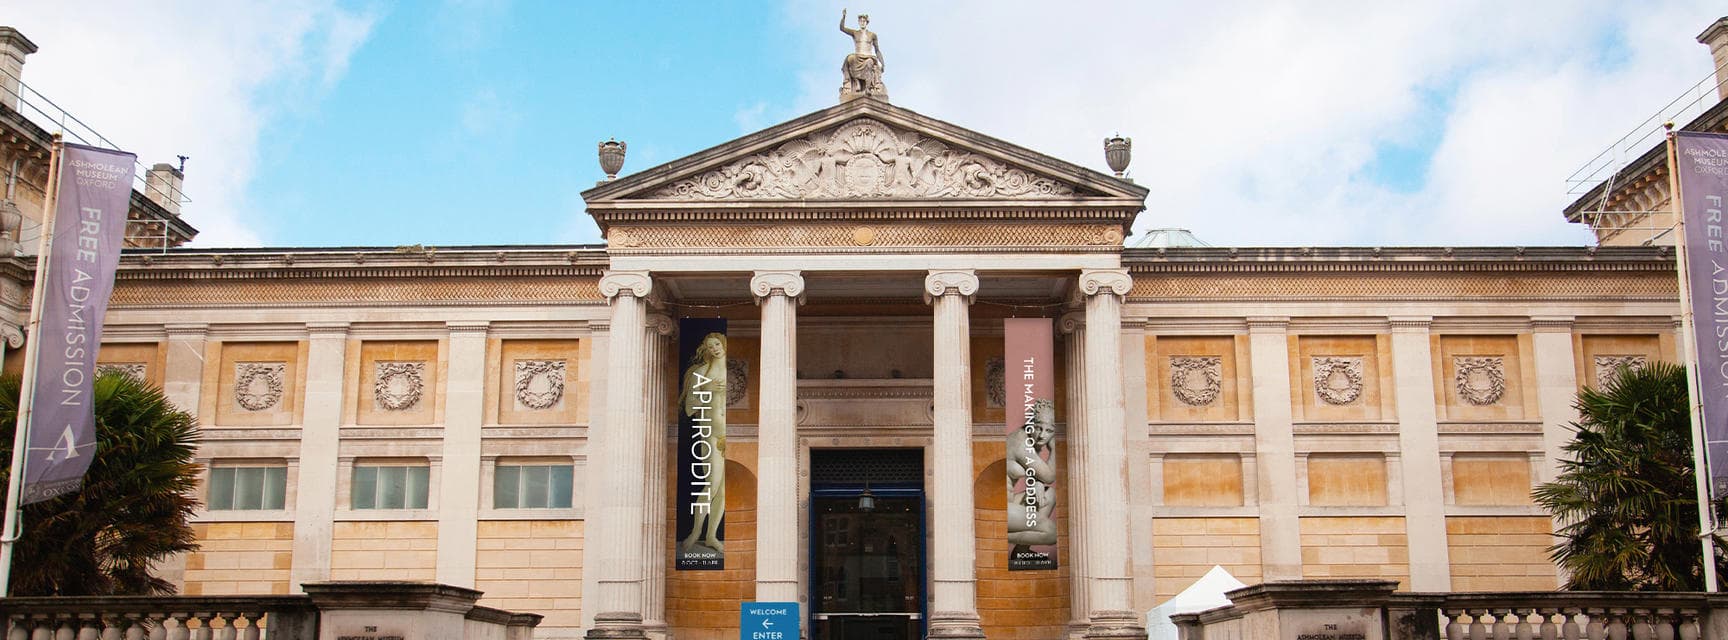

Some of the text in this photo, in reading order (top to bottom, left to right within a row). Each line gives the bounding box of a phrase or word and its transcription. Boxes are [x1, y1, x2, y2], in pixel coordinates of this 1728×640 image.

[1684, 148, 1727, 158] ASHMOLE
[69, 160, 129, 176] ASHMOLEAN
[76, 169, 118, 181] MUSEUM
[76, 177, 116, 189] OXFORD
[1706, 194, 1722, 253] FREE
[61, 207, 101, 406] FREE ADMISSION
[690, 371, 713, 515] APHRODITE
[1023, 357, 1037, 528] THE MAKING OF A GODDESS
[752, 631, 783, 640] ENTER
